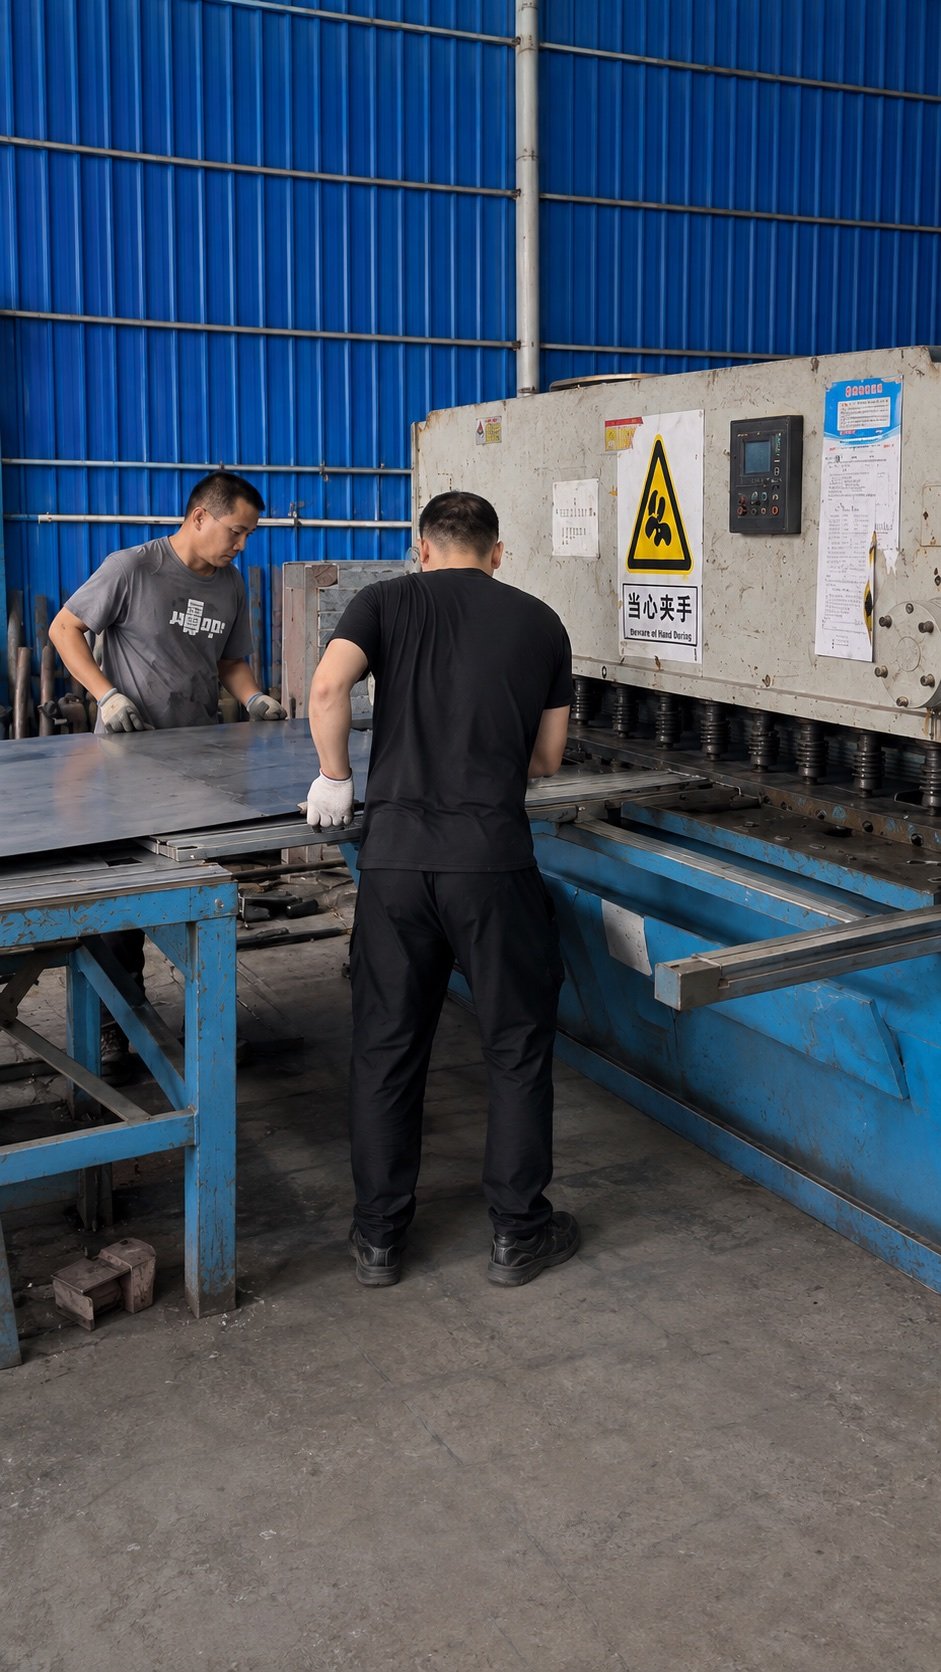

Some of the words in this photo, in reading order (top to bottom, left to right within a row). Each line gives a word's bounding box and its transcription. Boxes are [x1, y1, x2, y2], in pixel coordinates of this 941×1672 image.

[628, 592, 692, 622] 当心夹手
[630, 628, 650, 637] Beware
[651, 630, 657, 638] of
